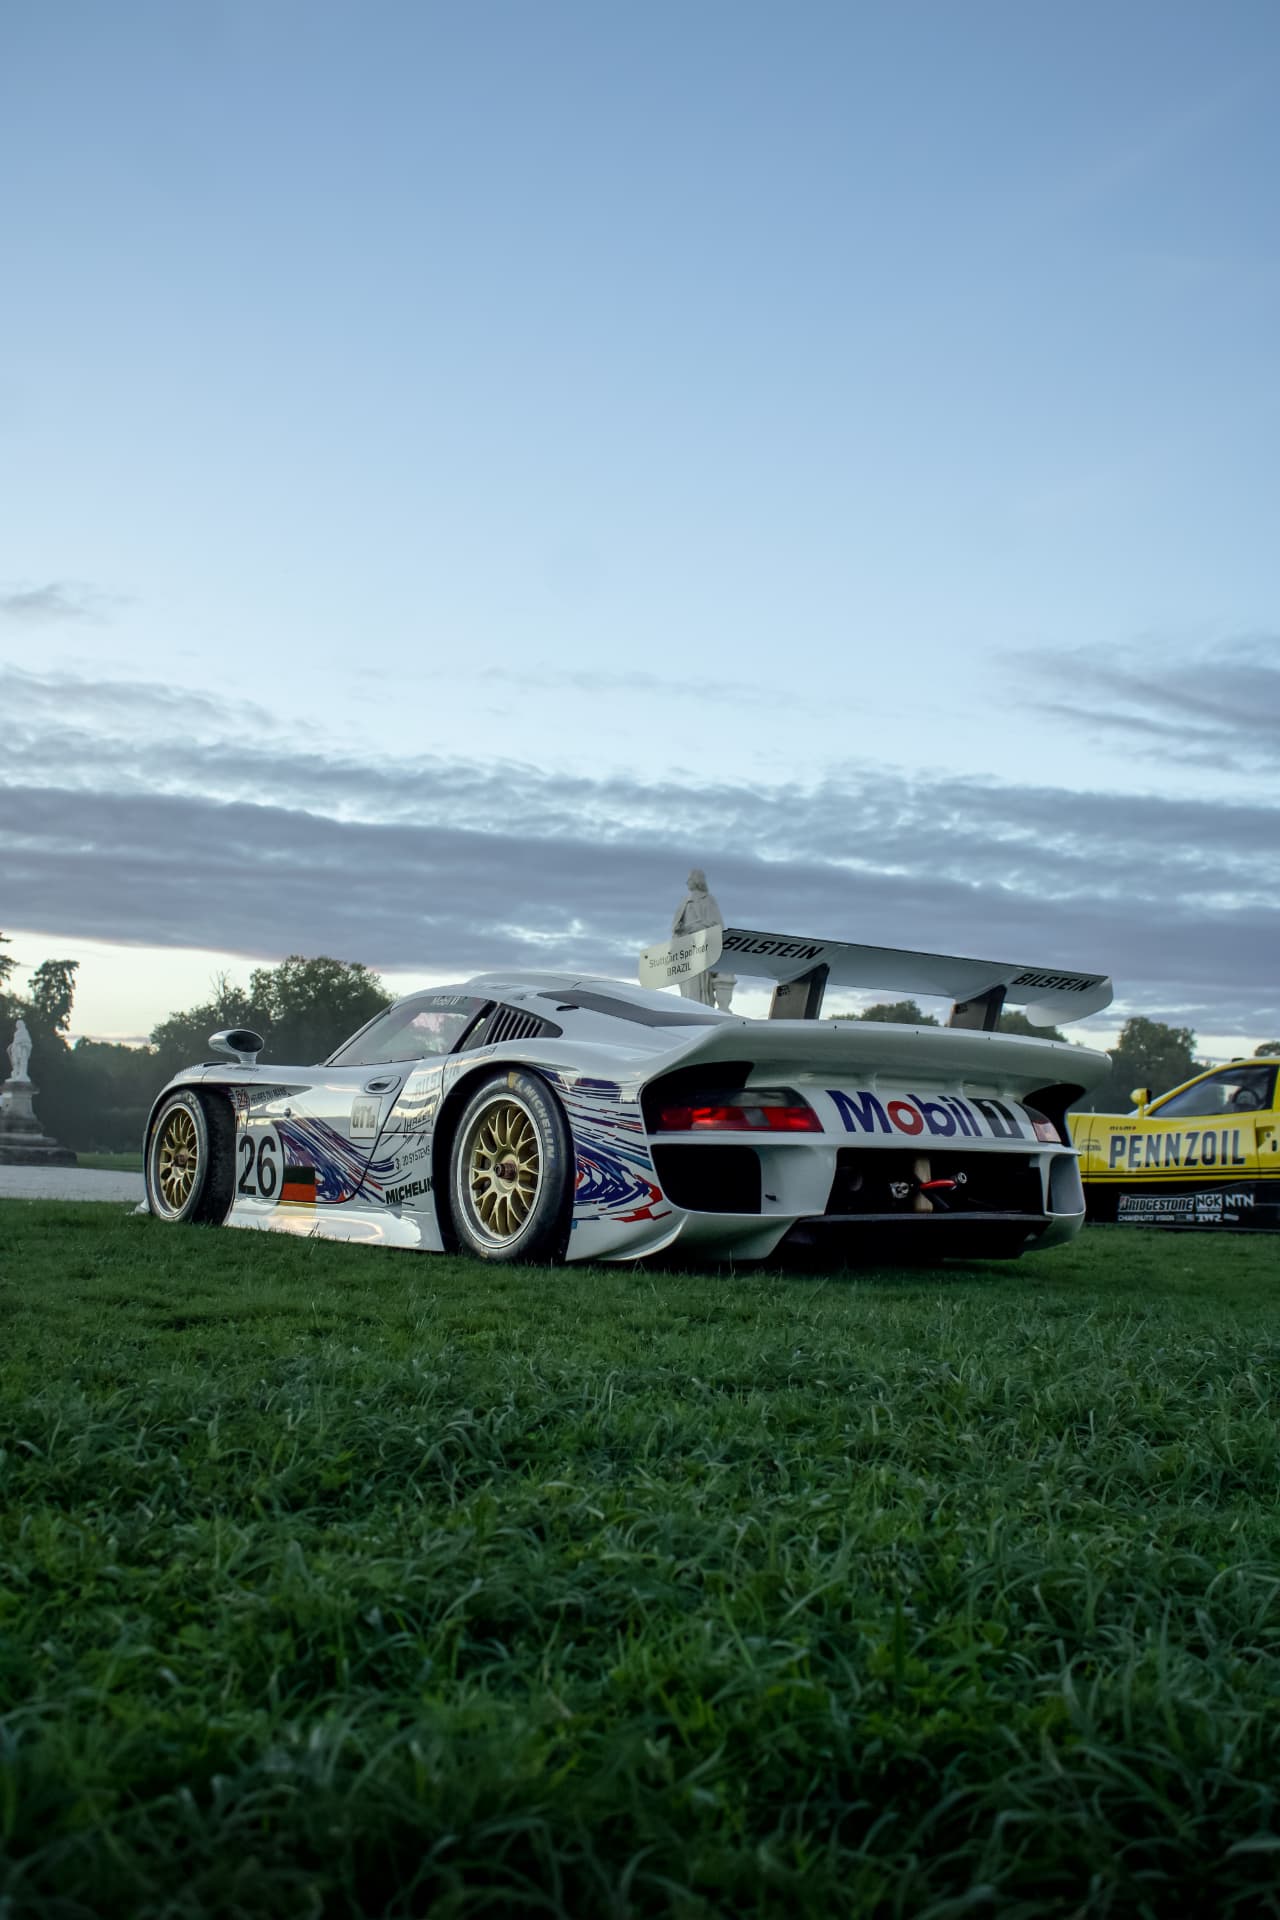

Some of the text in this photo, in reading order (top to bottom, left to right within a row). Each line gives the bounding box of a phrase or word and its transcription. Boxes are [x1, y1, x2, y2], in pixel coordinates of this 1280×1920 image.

[722, 935, 825, 960] BILSTEIN
[667, 963, 692, 977] BRAZIL
[1010, 973, 1098, 992] BILSTEIN
[522, 1084, 555, 1159] MICHELIN
[825, 1089, 983, 1137] Mobil
[1109, 1129, 1246, 1169] PENNZOIL
[238, 1135, 277, 1198] 26
[1118, 1194, 1254, 1212] BRIDGESTONE NGK NTN
